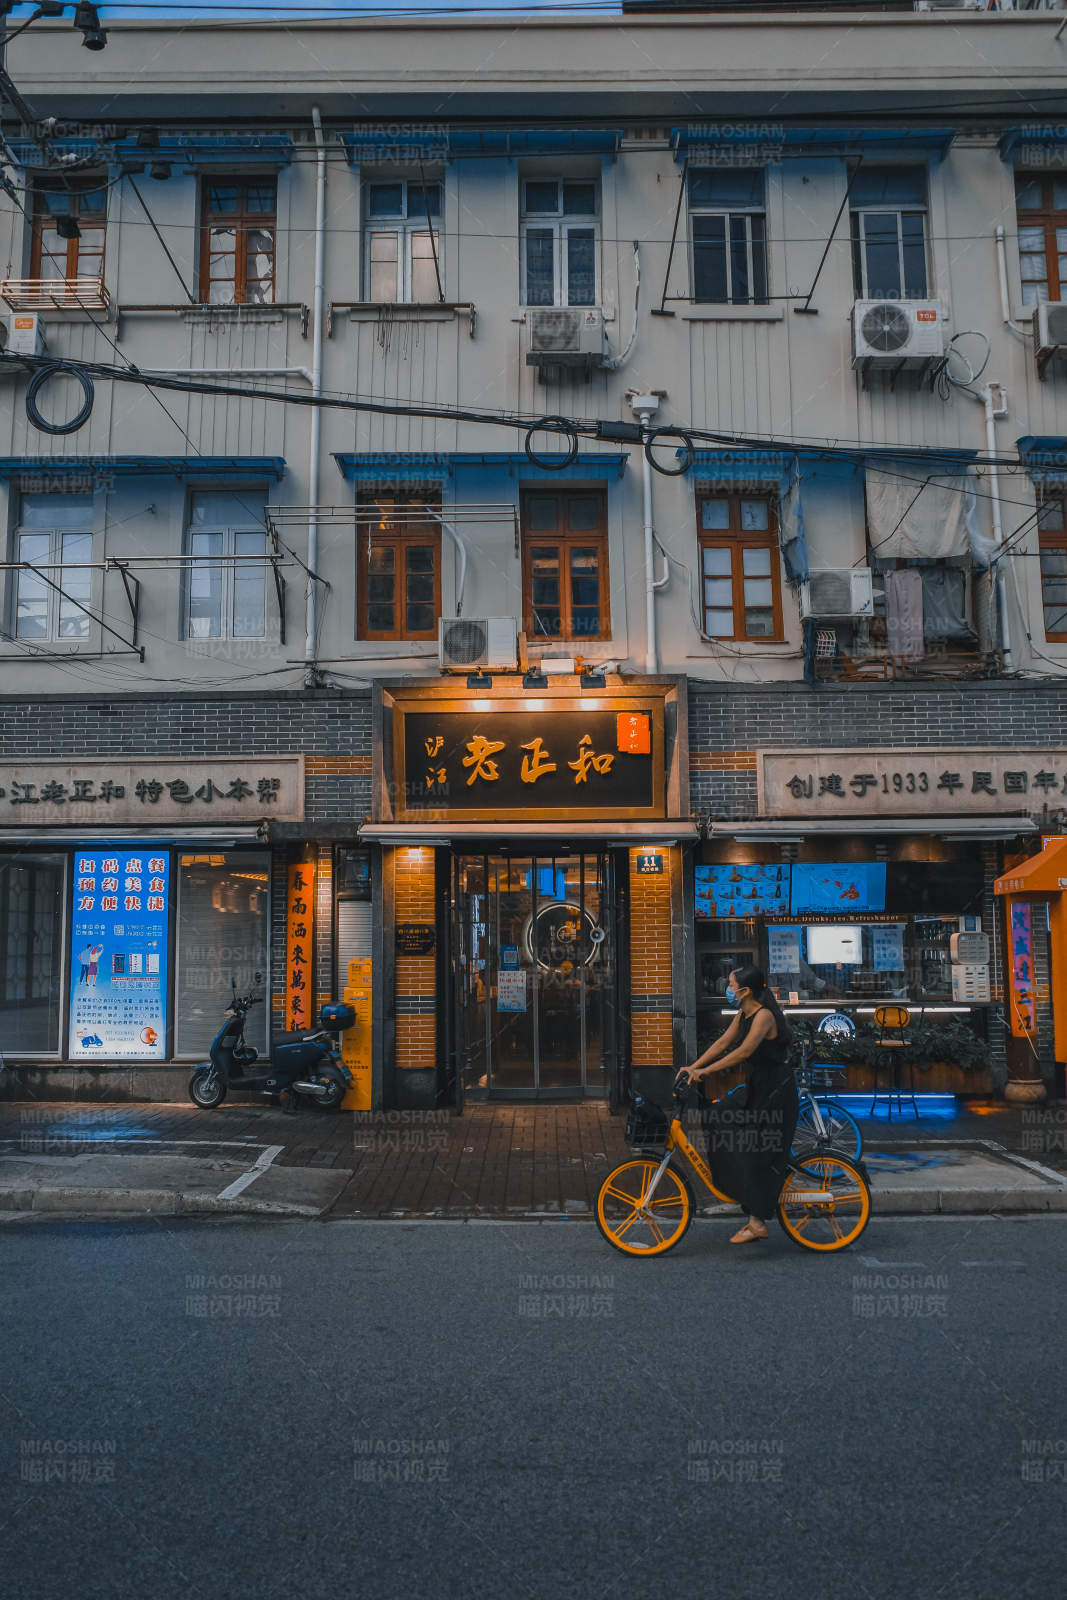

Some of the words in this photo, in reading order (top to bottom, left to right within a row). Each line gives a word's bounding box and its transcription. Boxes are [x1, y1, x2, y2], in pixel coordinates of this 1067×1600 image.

[462, 734, 616, 787] 老正和
[0, 780, 126, 805] 江老正和
[135, 777, 281, 804] 特色小本帮
[784, 769, 1067, 800] 创建于1933年民国年
[78, 858, 165, 874] 扫码点餐
[643, 856, 656, 867] 11
[77, 877, 165, 893] 预约美食
[77, 896, 164, 912] 方便快捷
